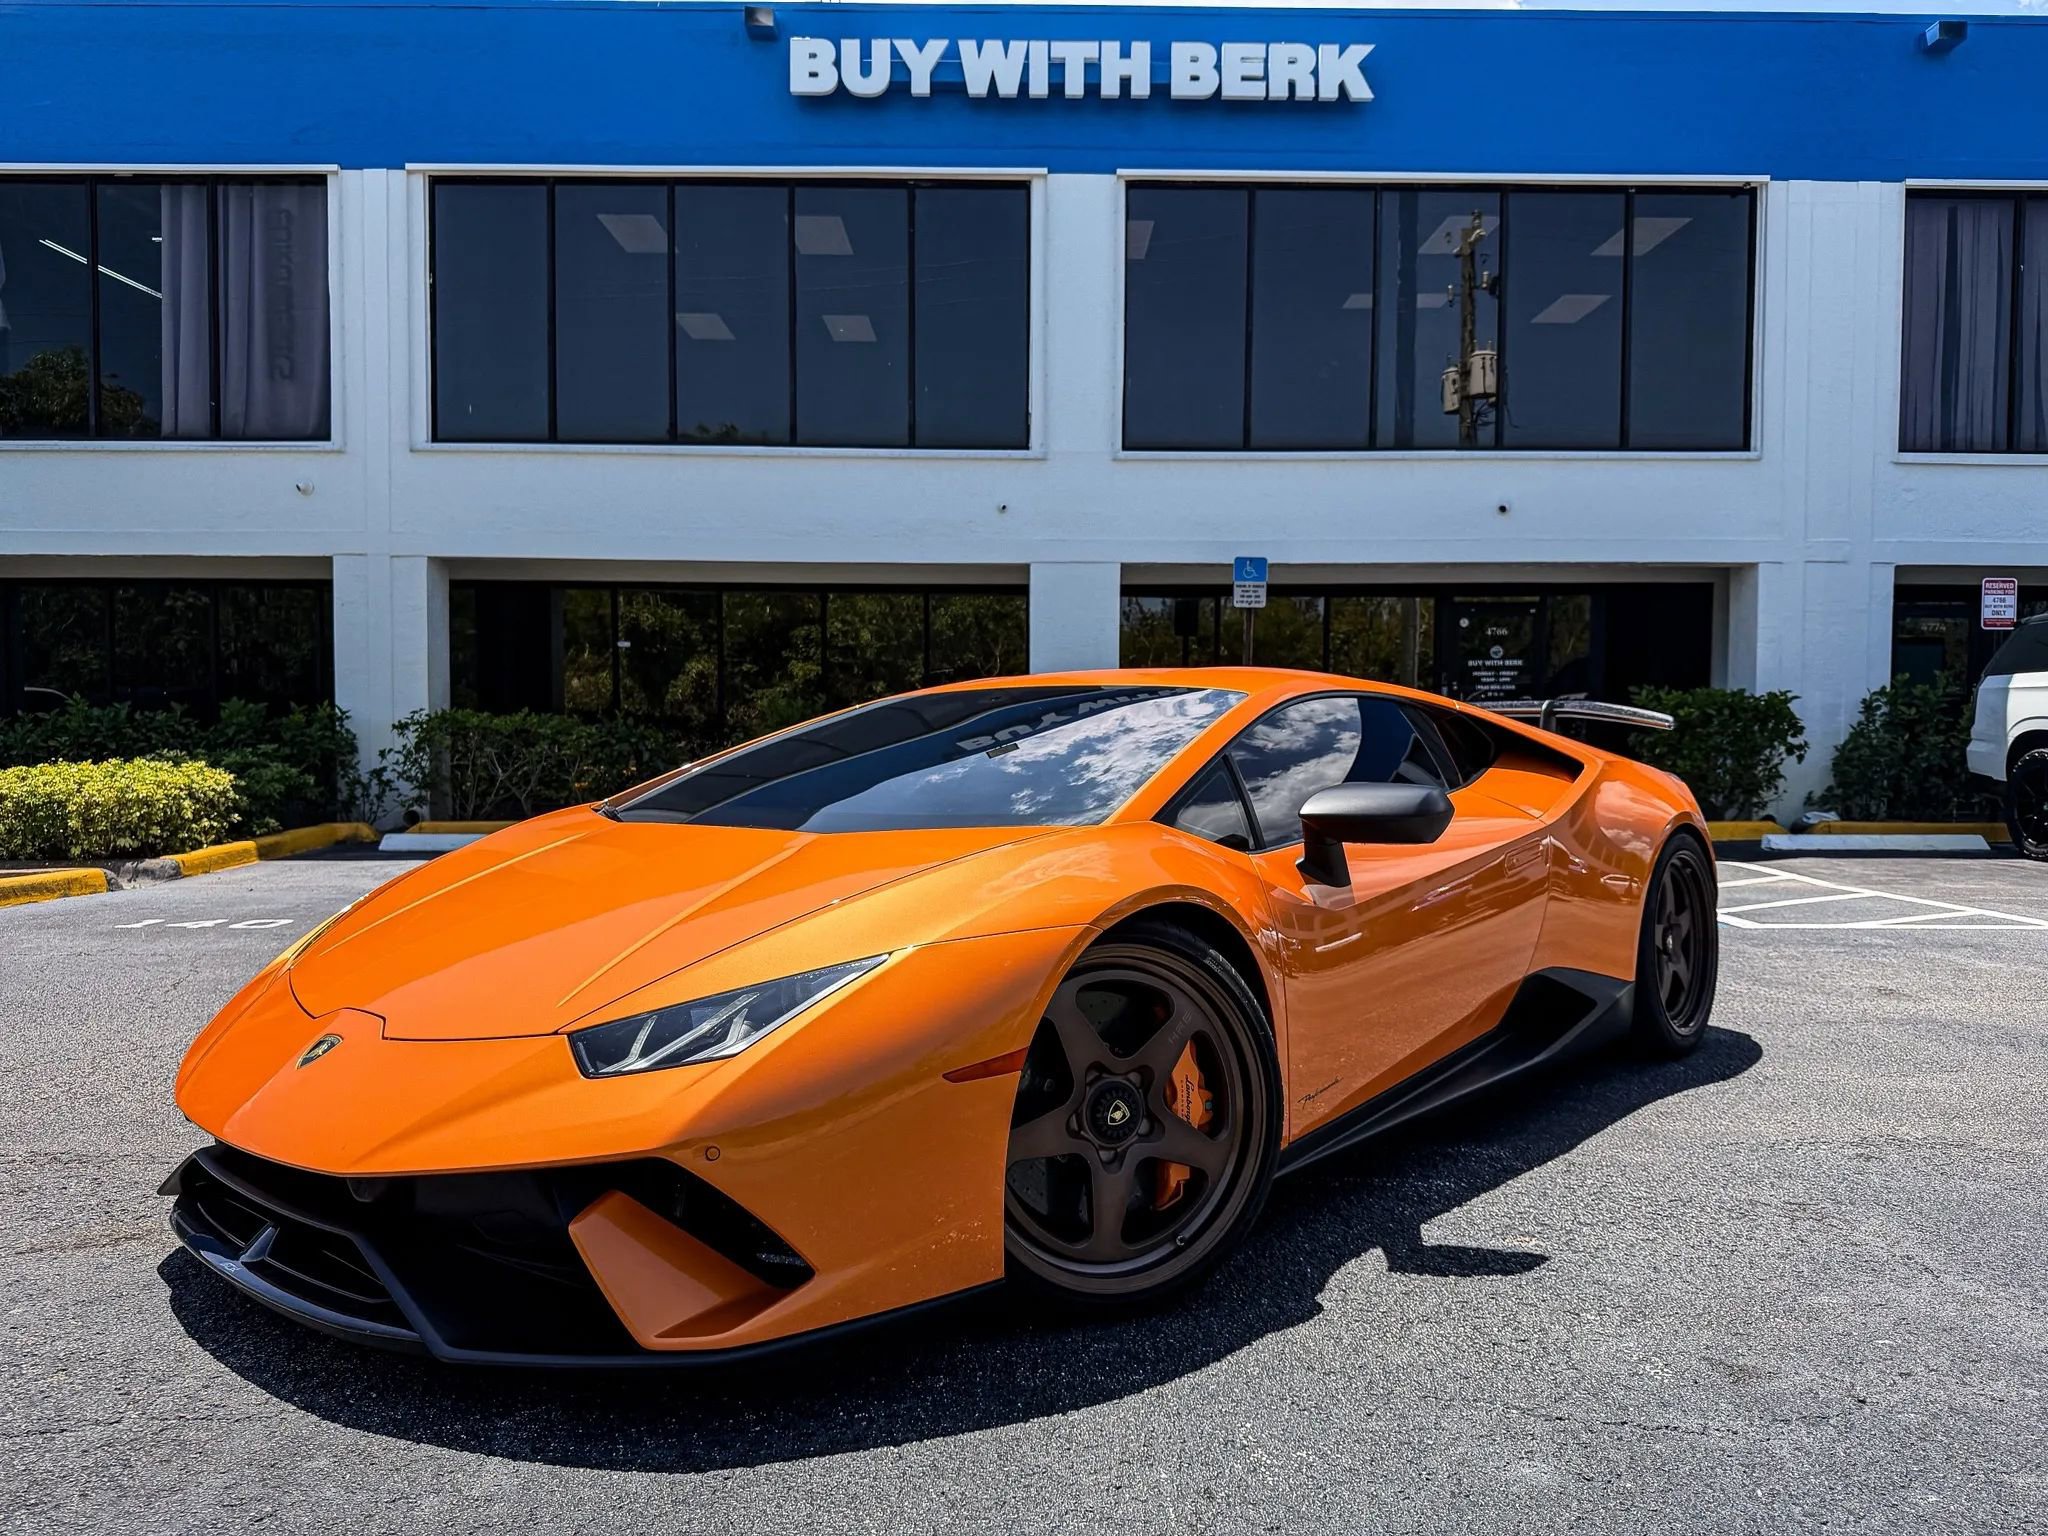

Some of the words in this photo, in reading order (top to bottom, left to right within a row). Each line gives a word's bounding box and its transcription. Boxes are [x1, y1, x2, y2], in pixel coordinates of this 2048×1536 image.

[790, 37, 948, 98] BUY
[958, 39, 1151, 99] WITH
[1170, 41, 1376, 102] BERK
[1486, 627, 1508, 636] 4766
